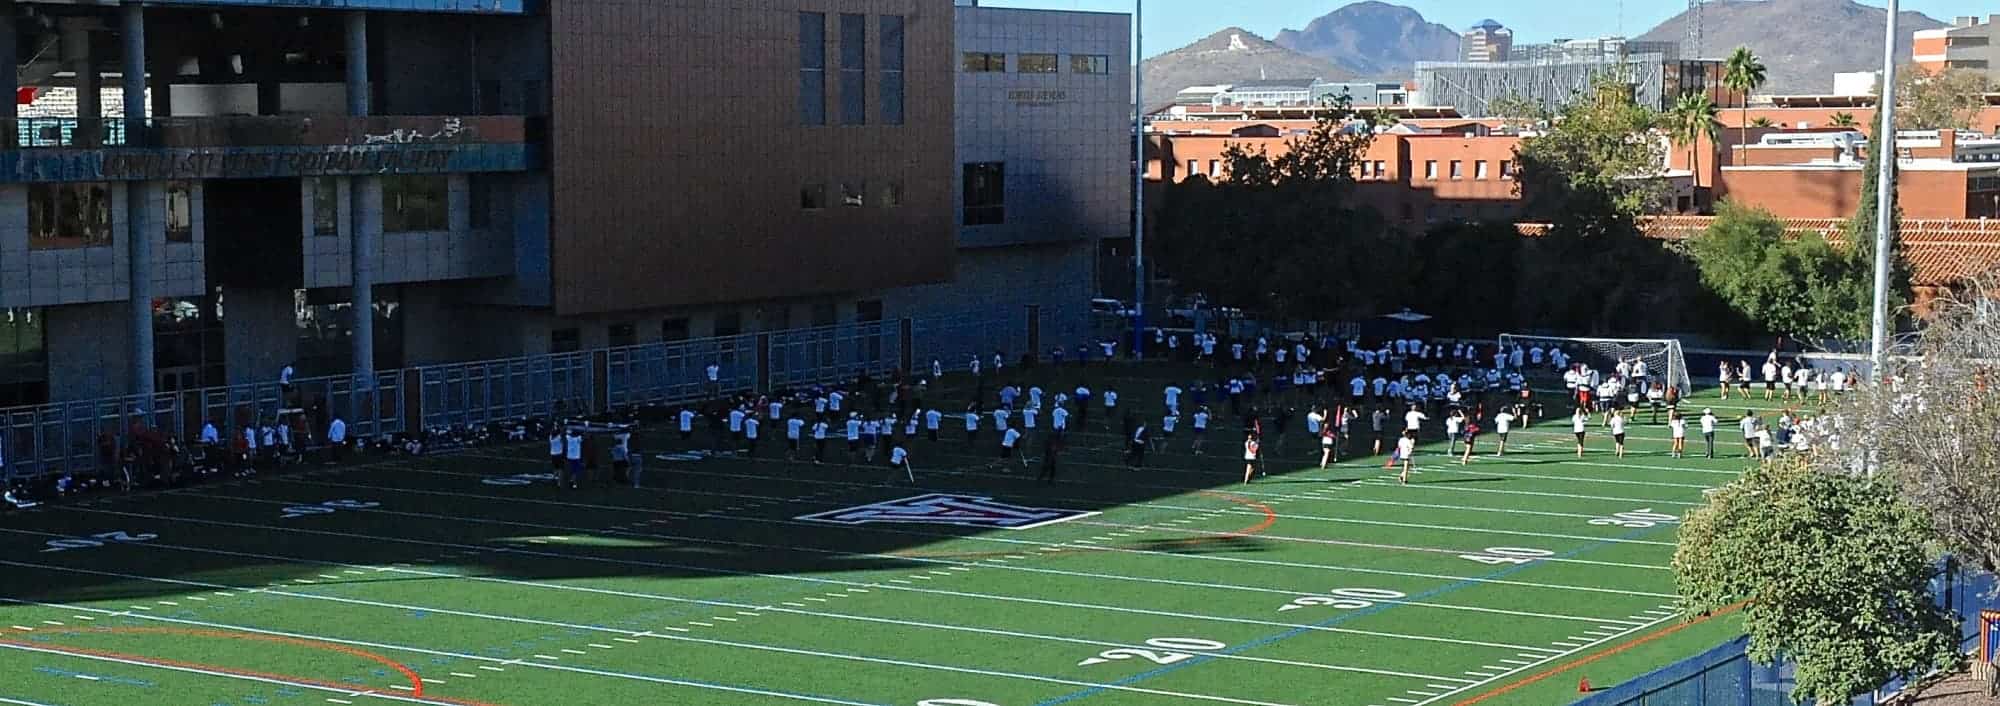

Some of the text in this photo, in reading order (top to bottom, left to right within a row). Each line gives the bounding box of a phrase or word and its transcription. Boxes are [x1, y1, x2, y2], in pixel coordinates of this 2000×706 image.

[1228, 34, 1249, 50] A
[1587, 511, 1680, 528] 30
[1458, 546, 1556, 565] 40
[1293, 587, 1407, 609] 30
[1099, 637, 1227, 664] 20
